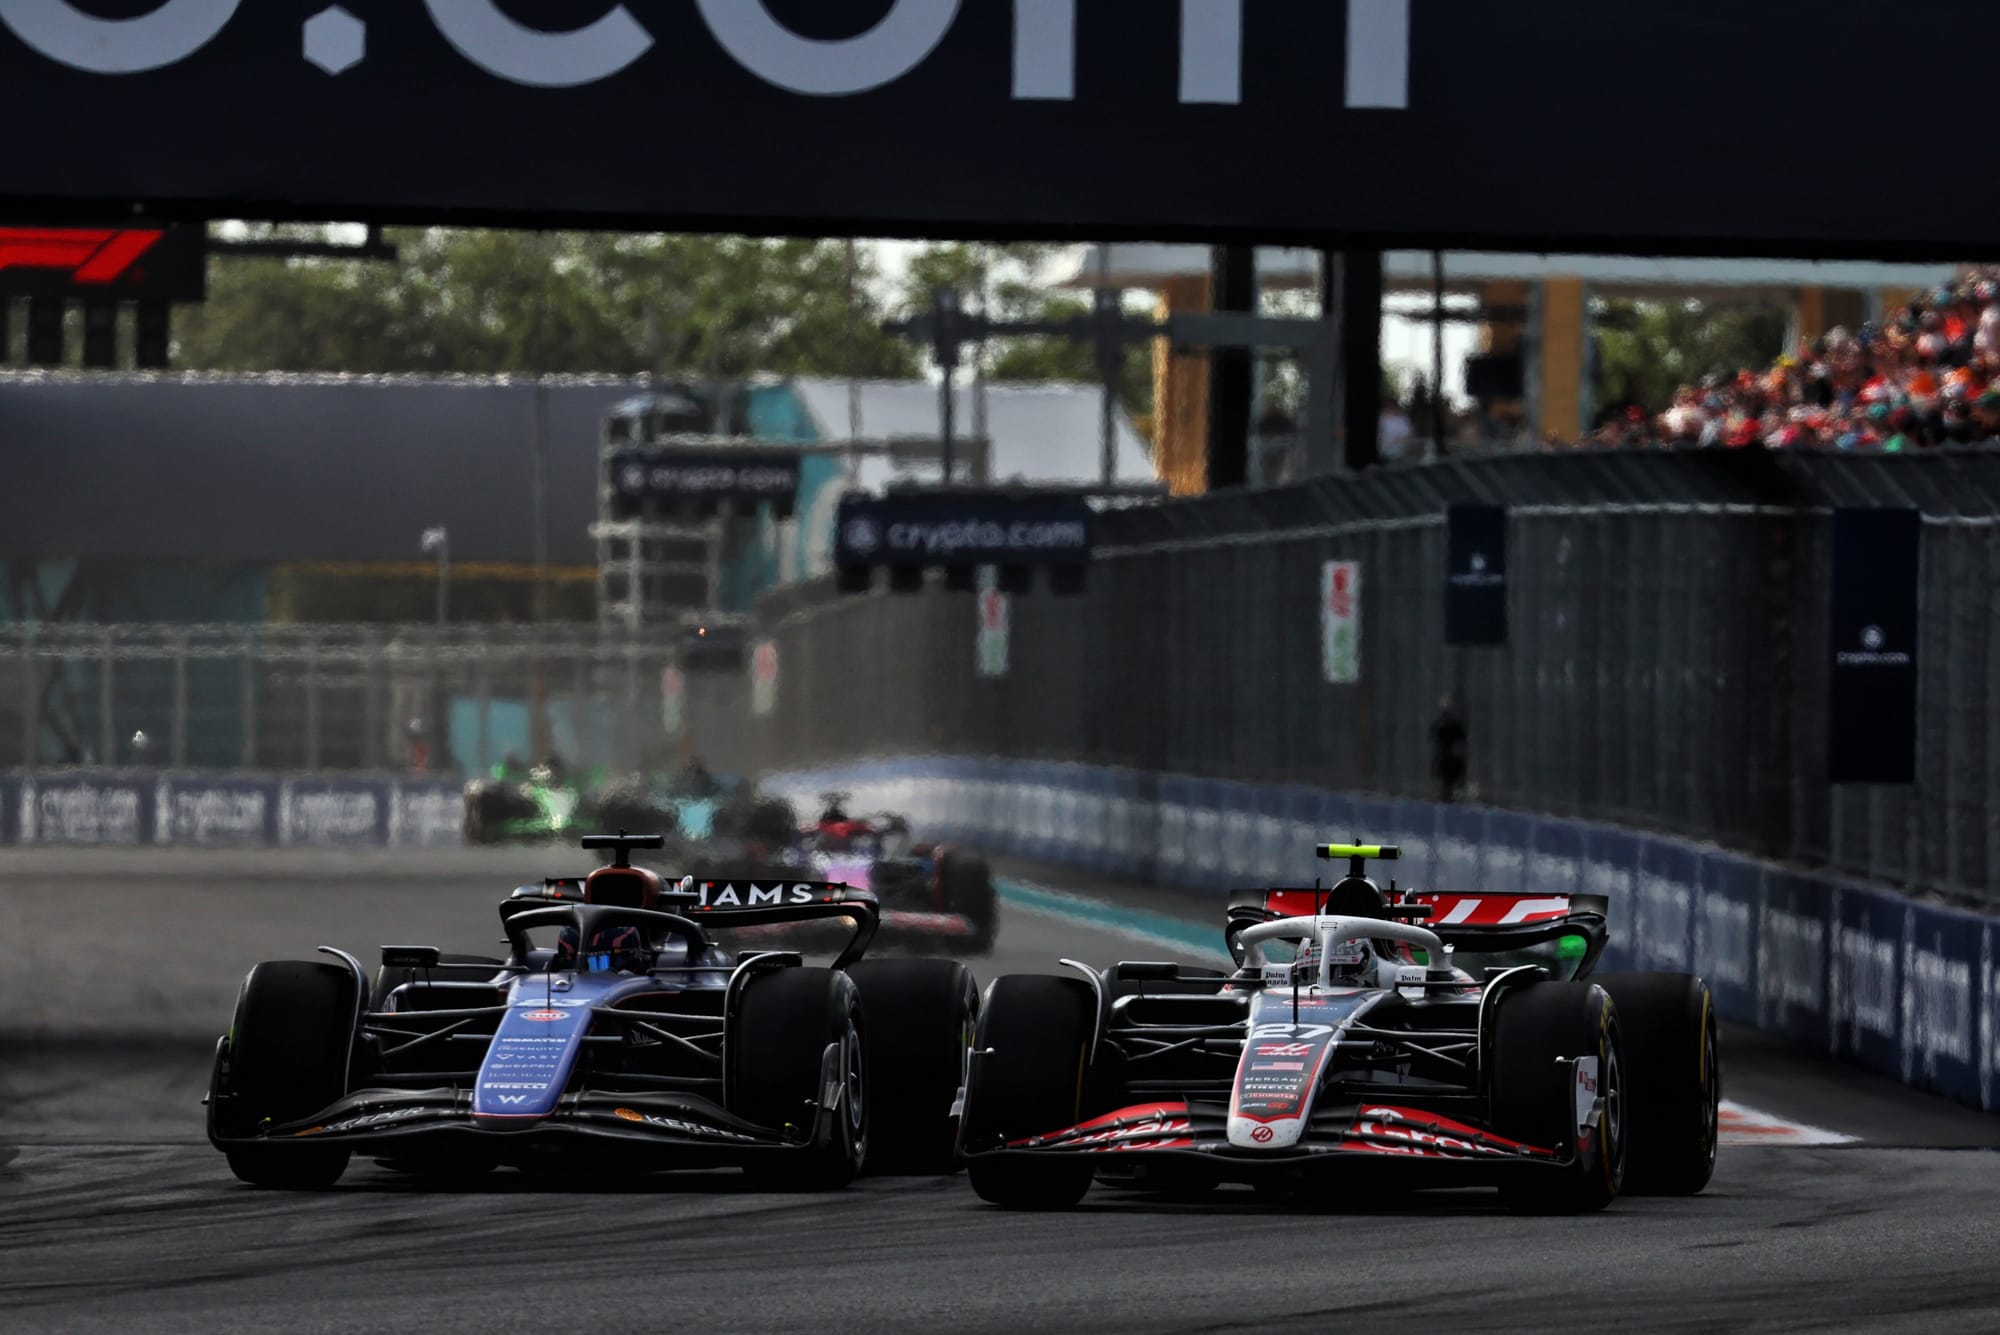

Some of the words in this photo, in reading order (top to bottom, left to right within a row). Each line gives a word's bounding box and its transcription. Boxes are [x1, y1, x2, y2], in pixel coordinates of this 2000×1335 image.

[886, 514, 1086, 553] crypto.com
[1265, 971, 1286, 980] Palm
[1252, 1023, 1334, 1039] 27
[645, 1114, 756, 1140] KEEPER
